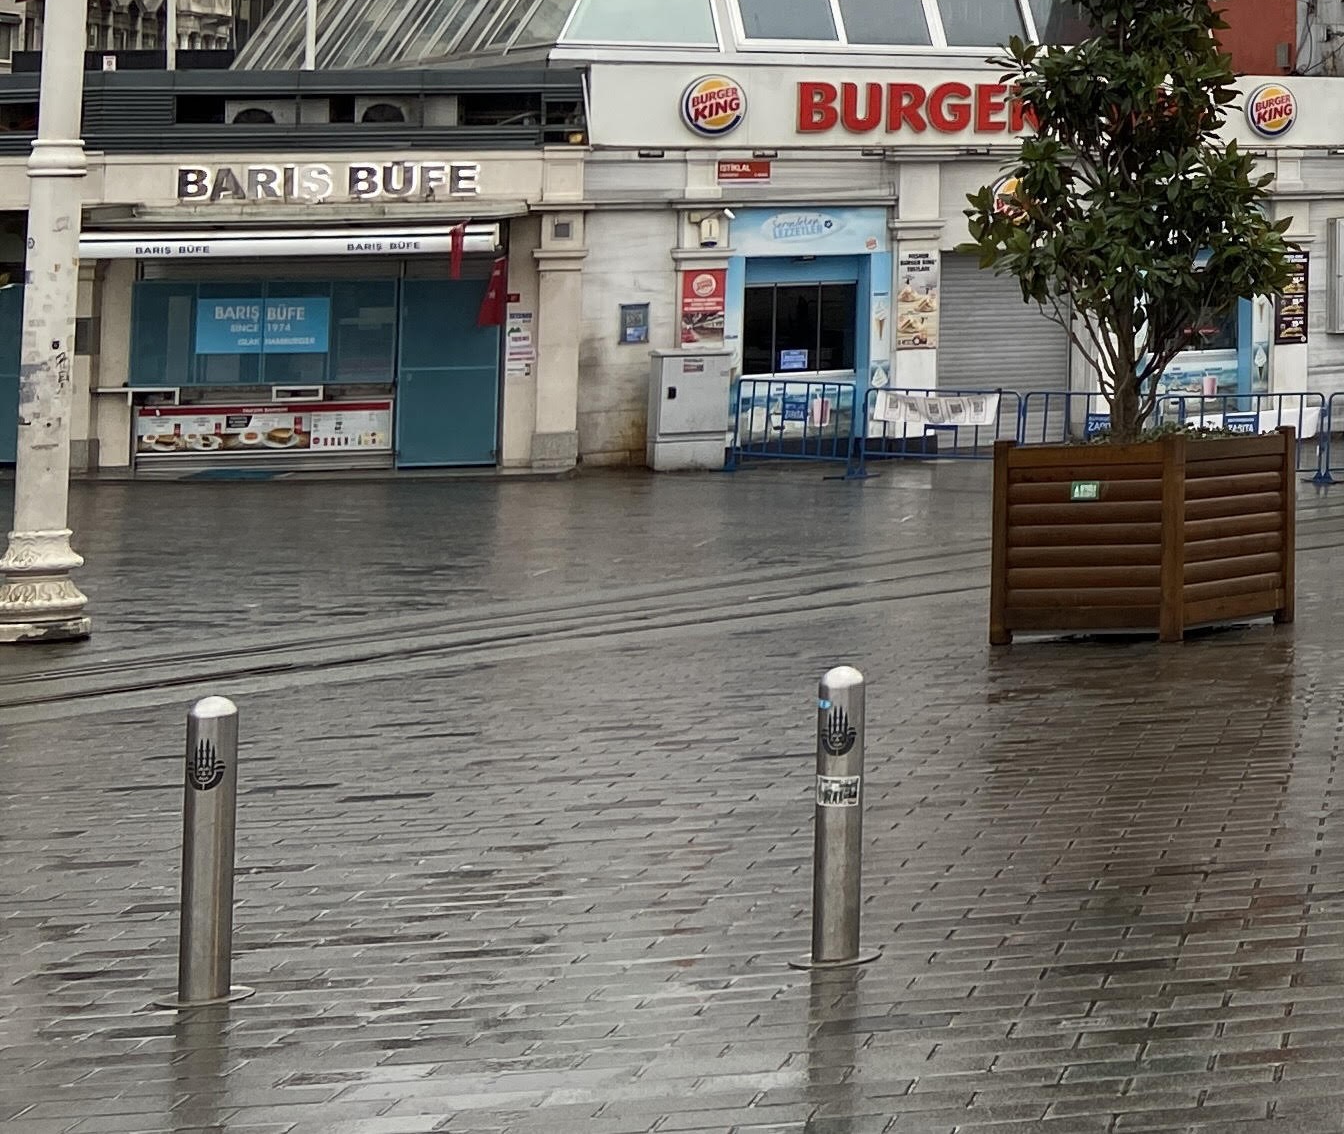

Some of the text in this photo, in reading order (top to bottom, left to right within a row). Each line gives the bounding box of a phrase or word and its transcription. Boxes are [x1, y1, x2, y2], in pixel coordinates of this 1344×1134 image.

[692, 87, 738, 108] BURGER
[1255, 94, 1291, 112] BURGER
[694, 97, 740, 123] KING
[1257, 103, 1293, 124] KING
[177, 161, 481, 204] BARIŞ BÜFE
[178, 244, 210, 254] BÜFE
[346, 240, 421, 252] BARIŞ BÜFE
[214, 304, 305, 322] BARIŞ BÜFE
[267, 323, 291, 332] 1974
